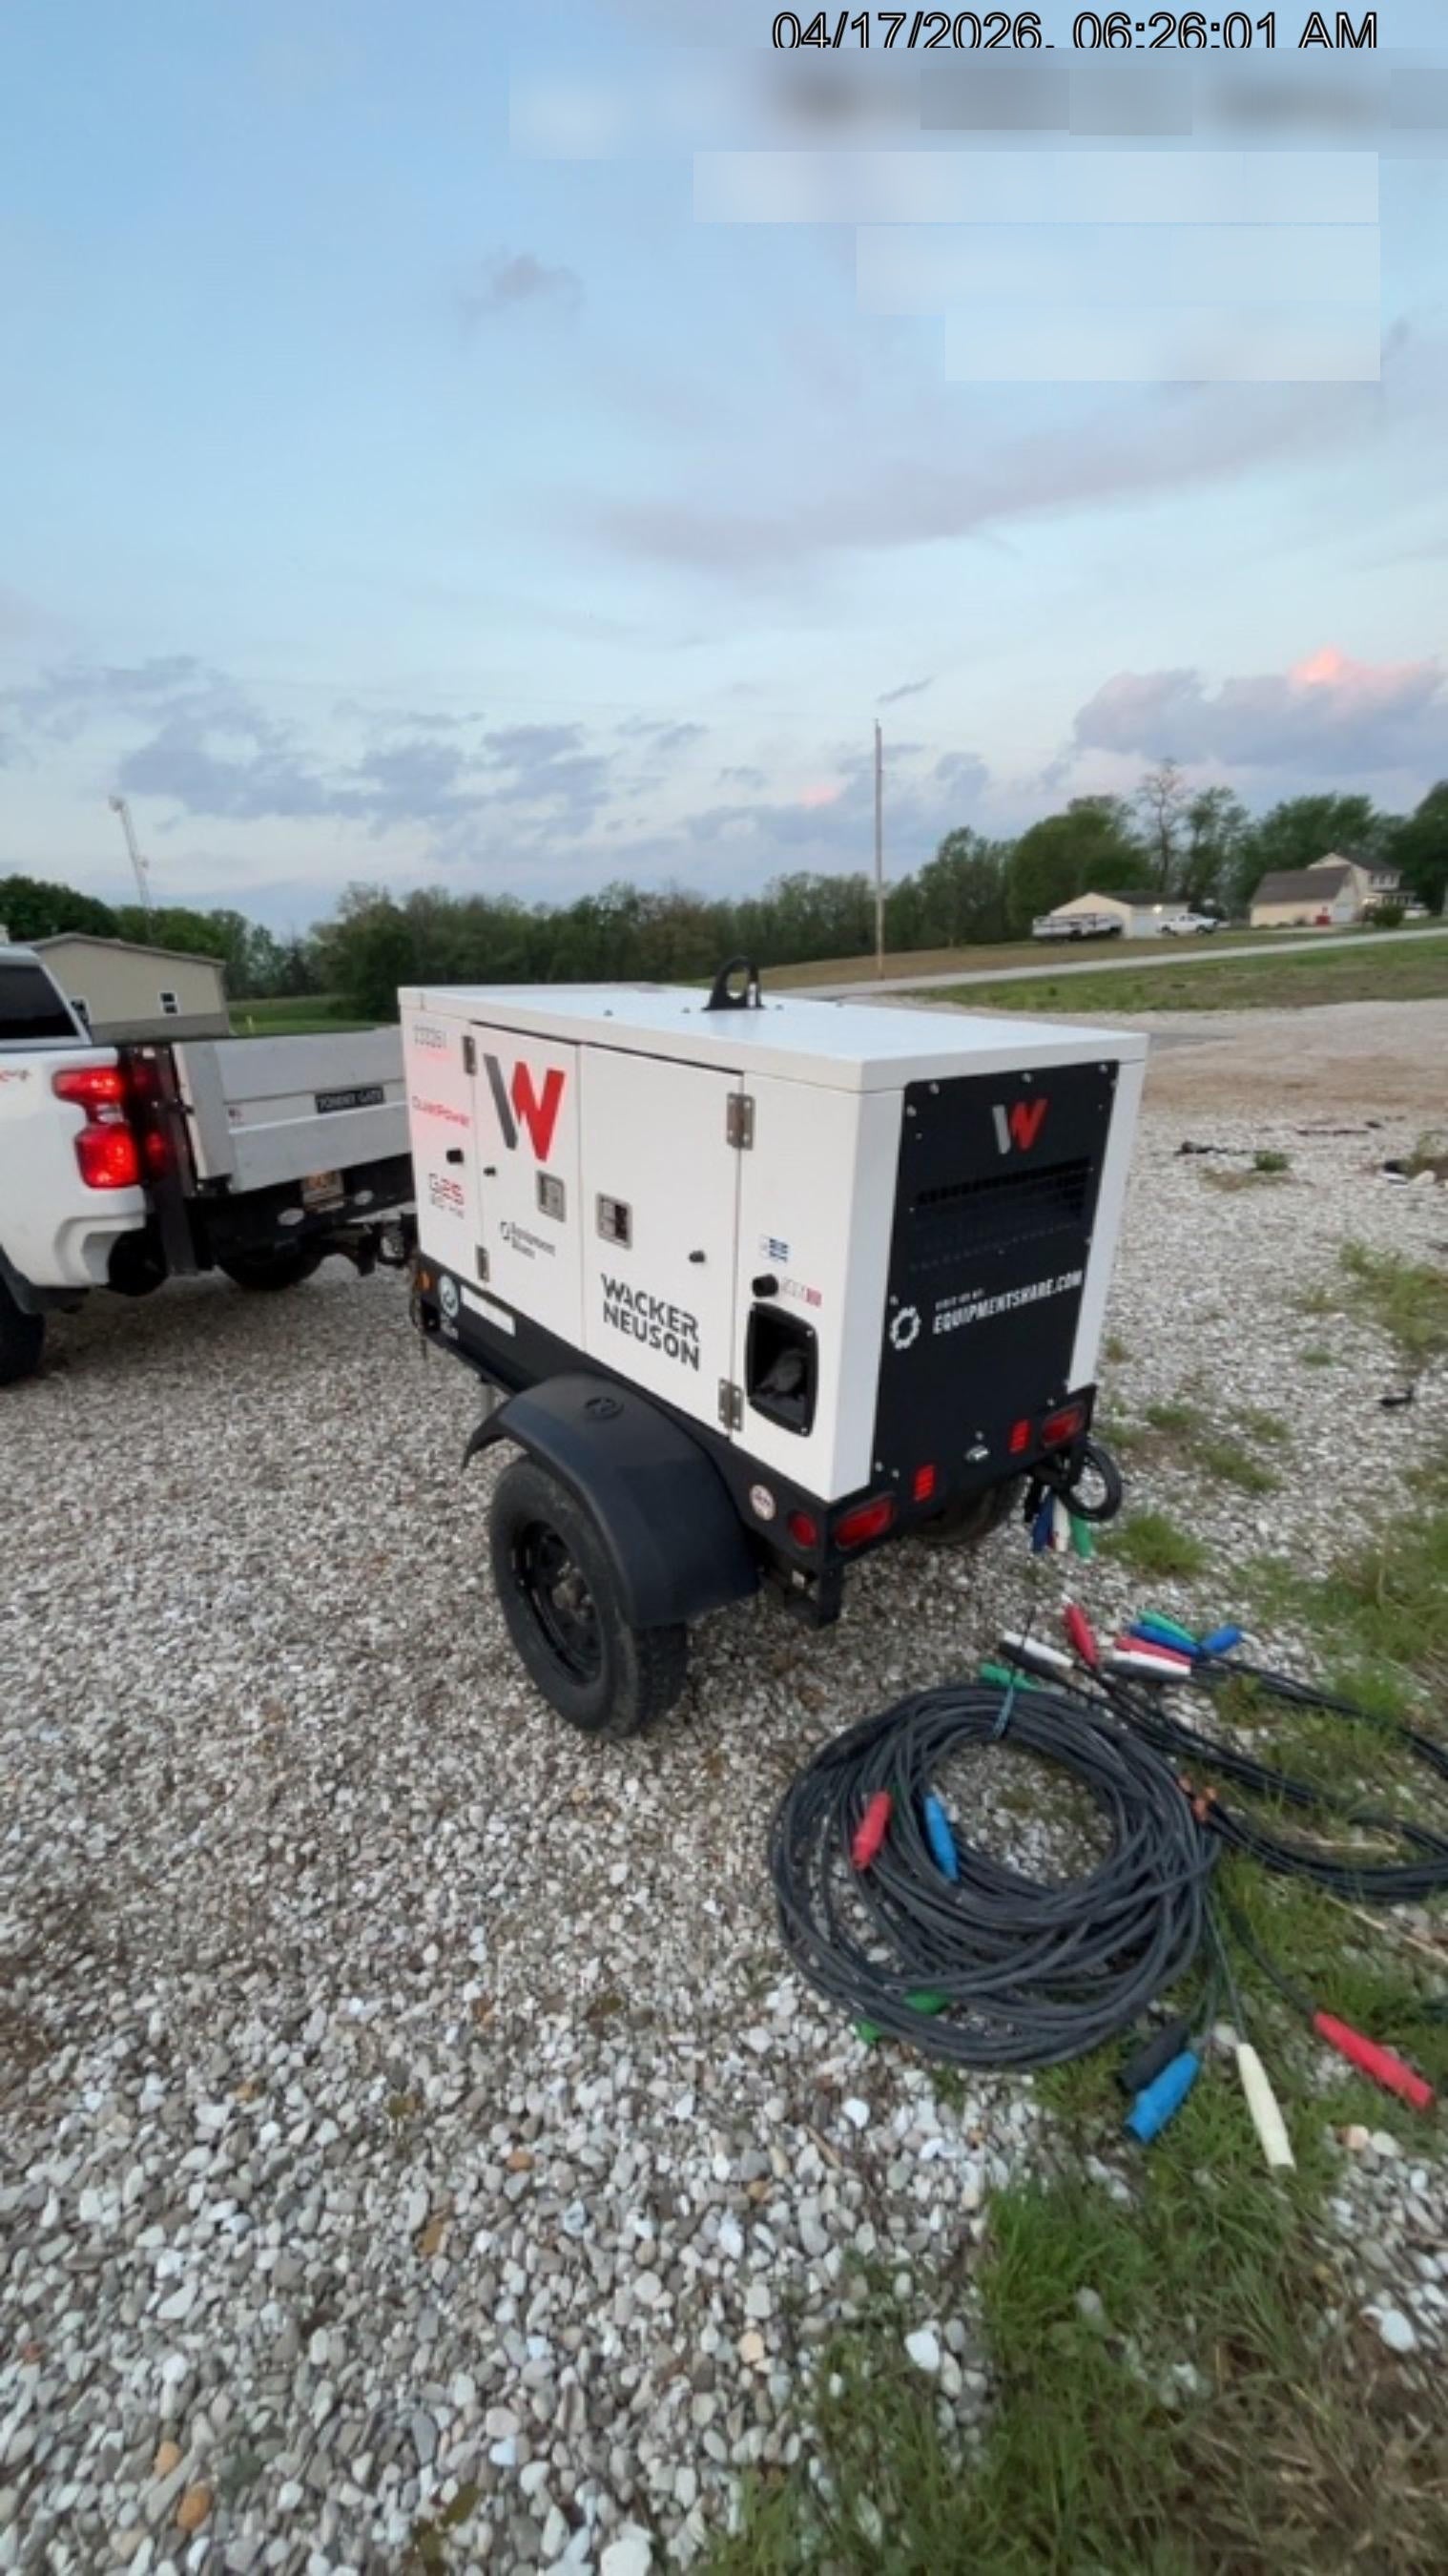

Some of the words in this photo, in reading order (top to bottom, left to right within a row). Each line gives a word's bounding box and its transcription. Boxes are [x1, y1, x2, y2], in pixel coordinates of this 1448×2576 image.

[600, 1272, 700, 1343] WACKER
[603, 1299, 700, 1372] NEUSON
[932, 1269, 1084, 1335] EQUIPMENTSHARE.COM
